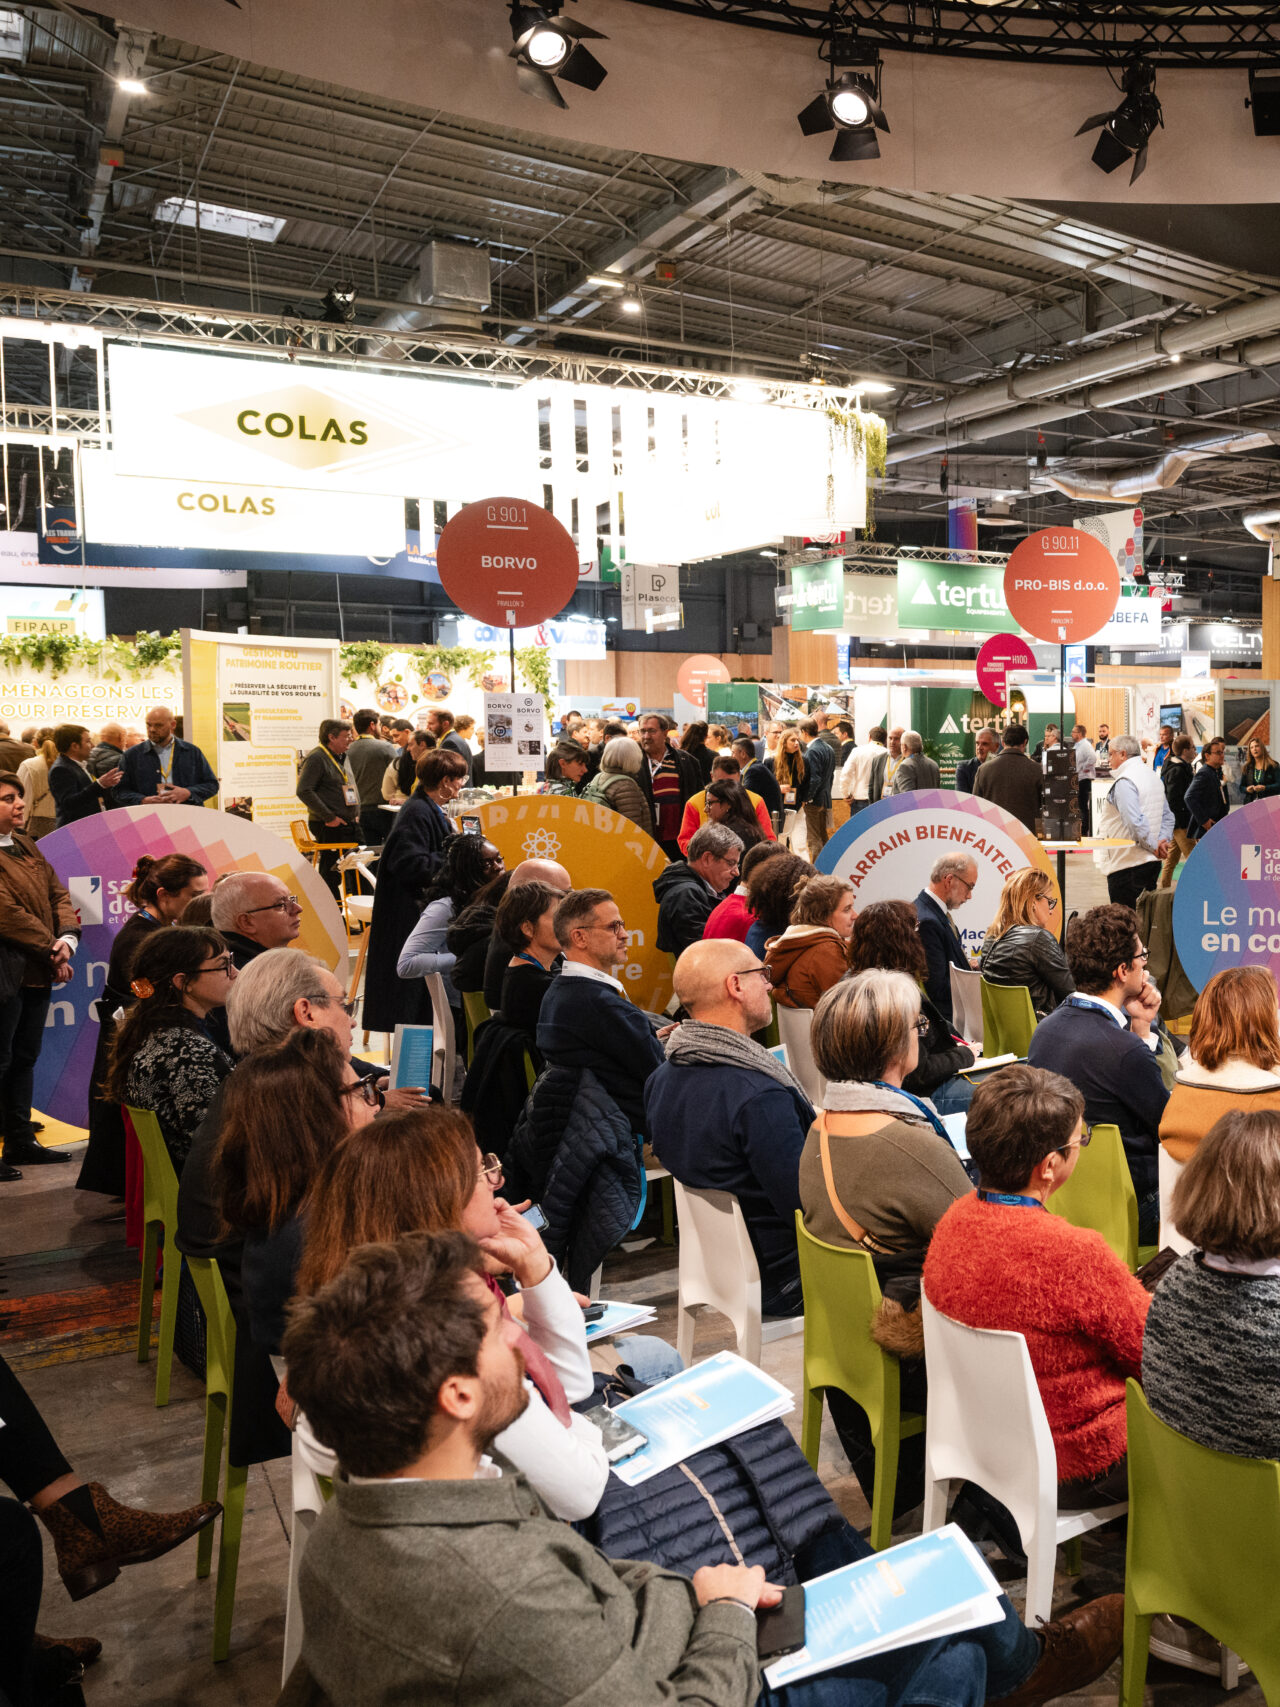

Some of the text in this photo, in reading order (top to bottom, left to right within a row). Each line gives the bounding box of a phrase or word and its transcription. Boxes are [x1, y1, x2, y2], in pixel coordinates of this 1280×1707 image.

[237, 410, 369, 446] COLAS
[176, 492, 276, 516] COLAS
[487, 506, 527, 522] G 90.1
[1041, 535, 1079, 550] G 90.11
[481, 555, 537, 570] BORVO
[1014, 580, 1109, 591] PRO-BIS d.o.o.
[638, 593, 676, 602] Plaseco
[15, 622, 68, 632] FIRALP
[536, 624, 548, 646] &
[243, 648, 298, 659] GESTION DU
[1012, 655, 1028, 664] H100
[280, 661, 322, 671] ROUTIER
[1, 681, 174, 699] MÉNAGEONS LES
[1, 704, 46, 718] OUR
[848, 829, 911, 888] ARRAIN
[108, 894, 138, 914] de
[1204, 900, 1238, 926] Le
[1202, 932, 1240, 952] en
